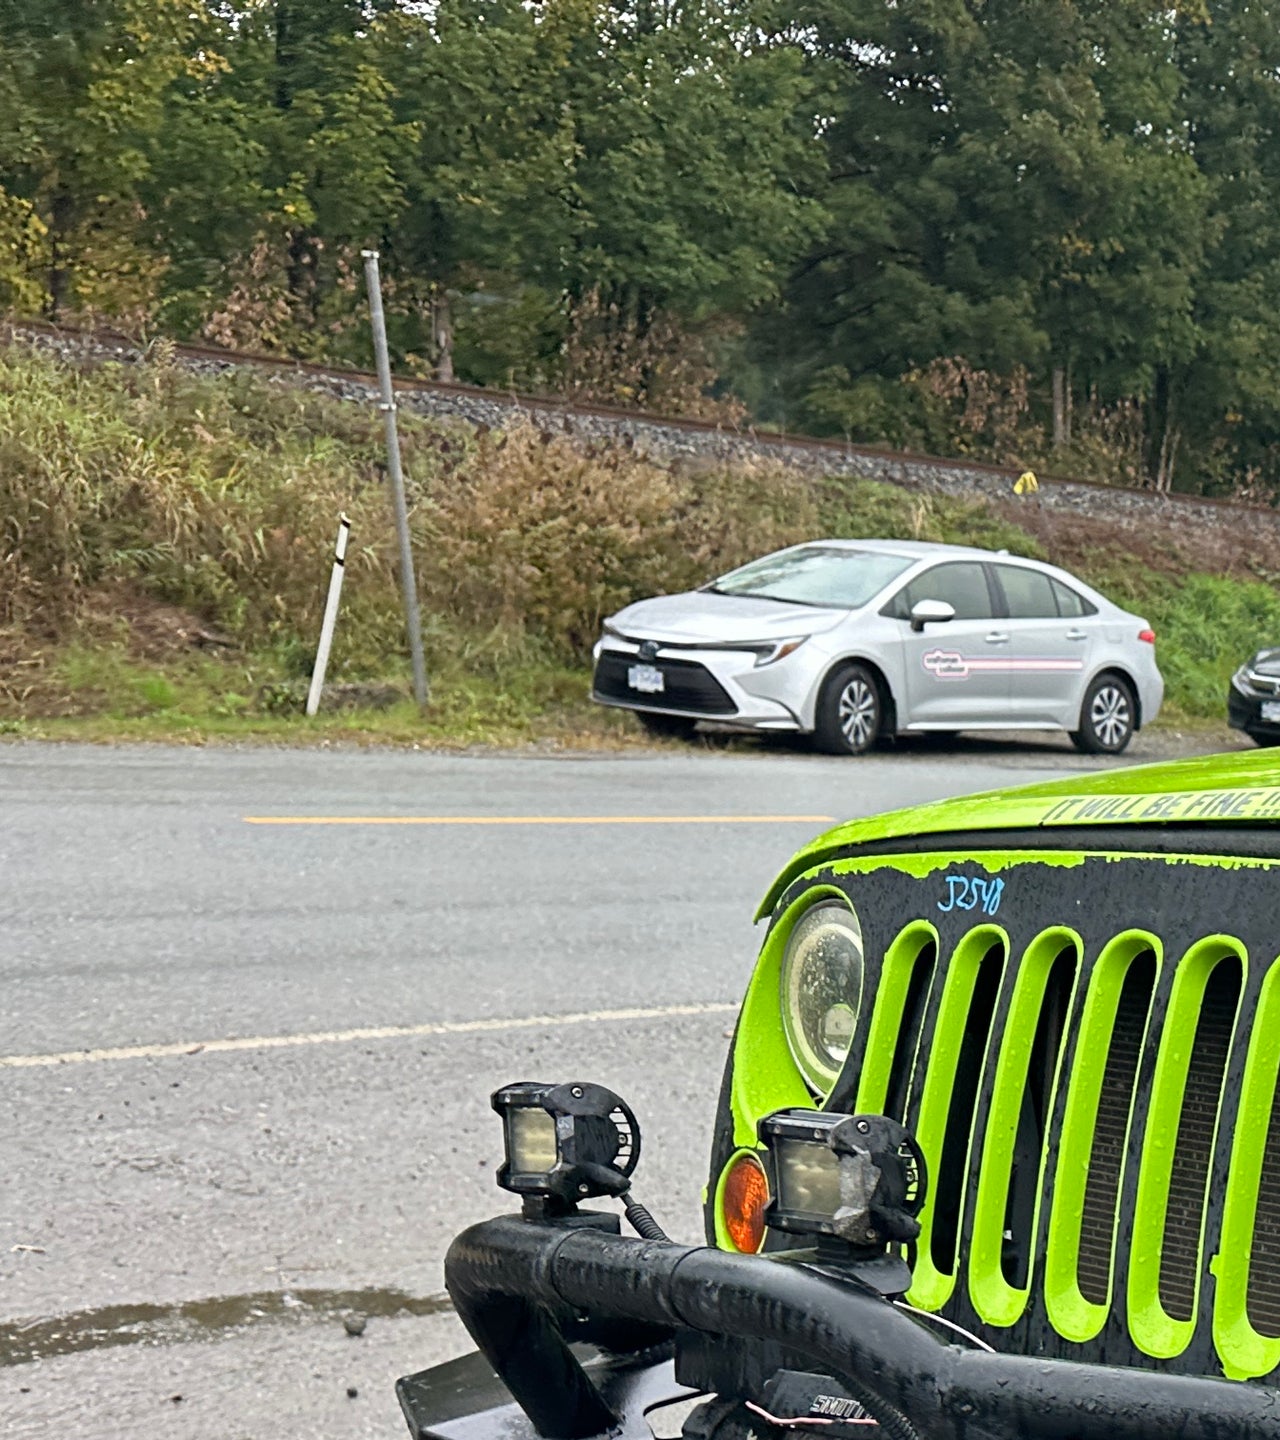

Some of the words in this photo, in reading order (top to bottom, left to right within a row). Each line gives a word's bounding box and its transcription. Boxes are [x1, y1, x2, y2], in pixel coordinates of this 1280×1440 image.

[1042, 799, 1083, 820] IT
[1073, 797, 1146, 820] WILL
[1139, 794, 1194, 818] BE
[1181, 792, 1264, 817] FINE
[936, 875, 1005, 916] J2548
